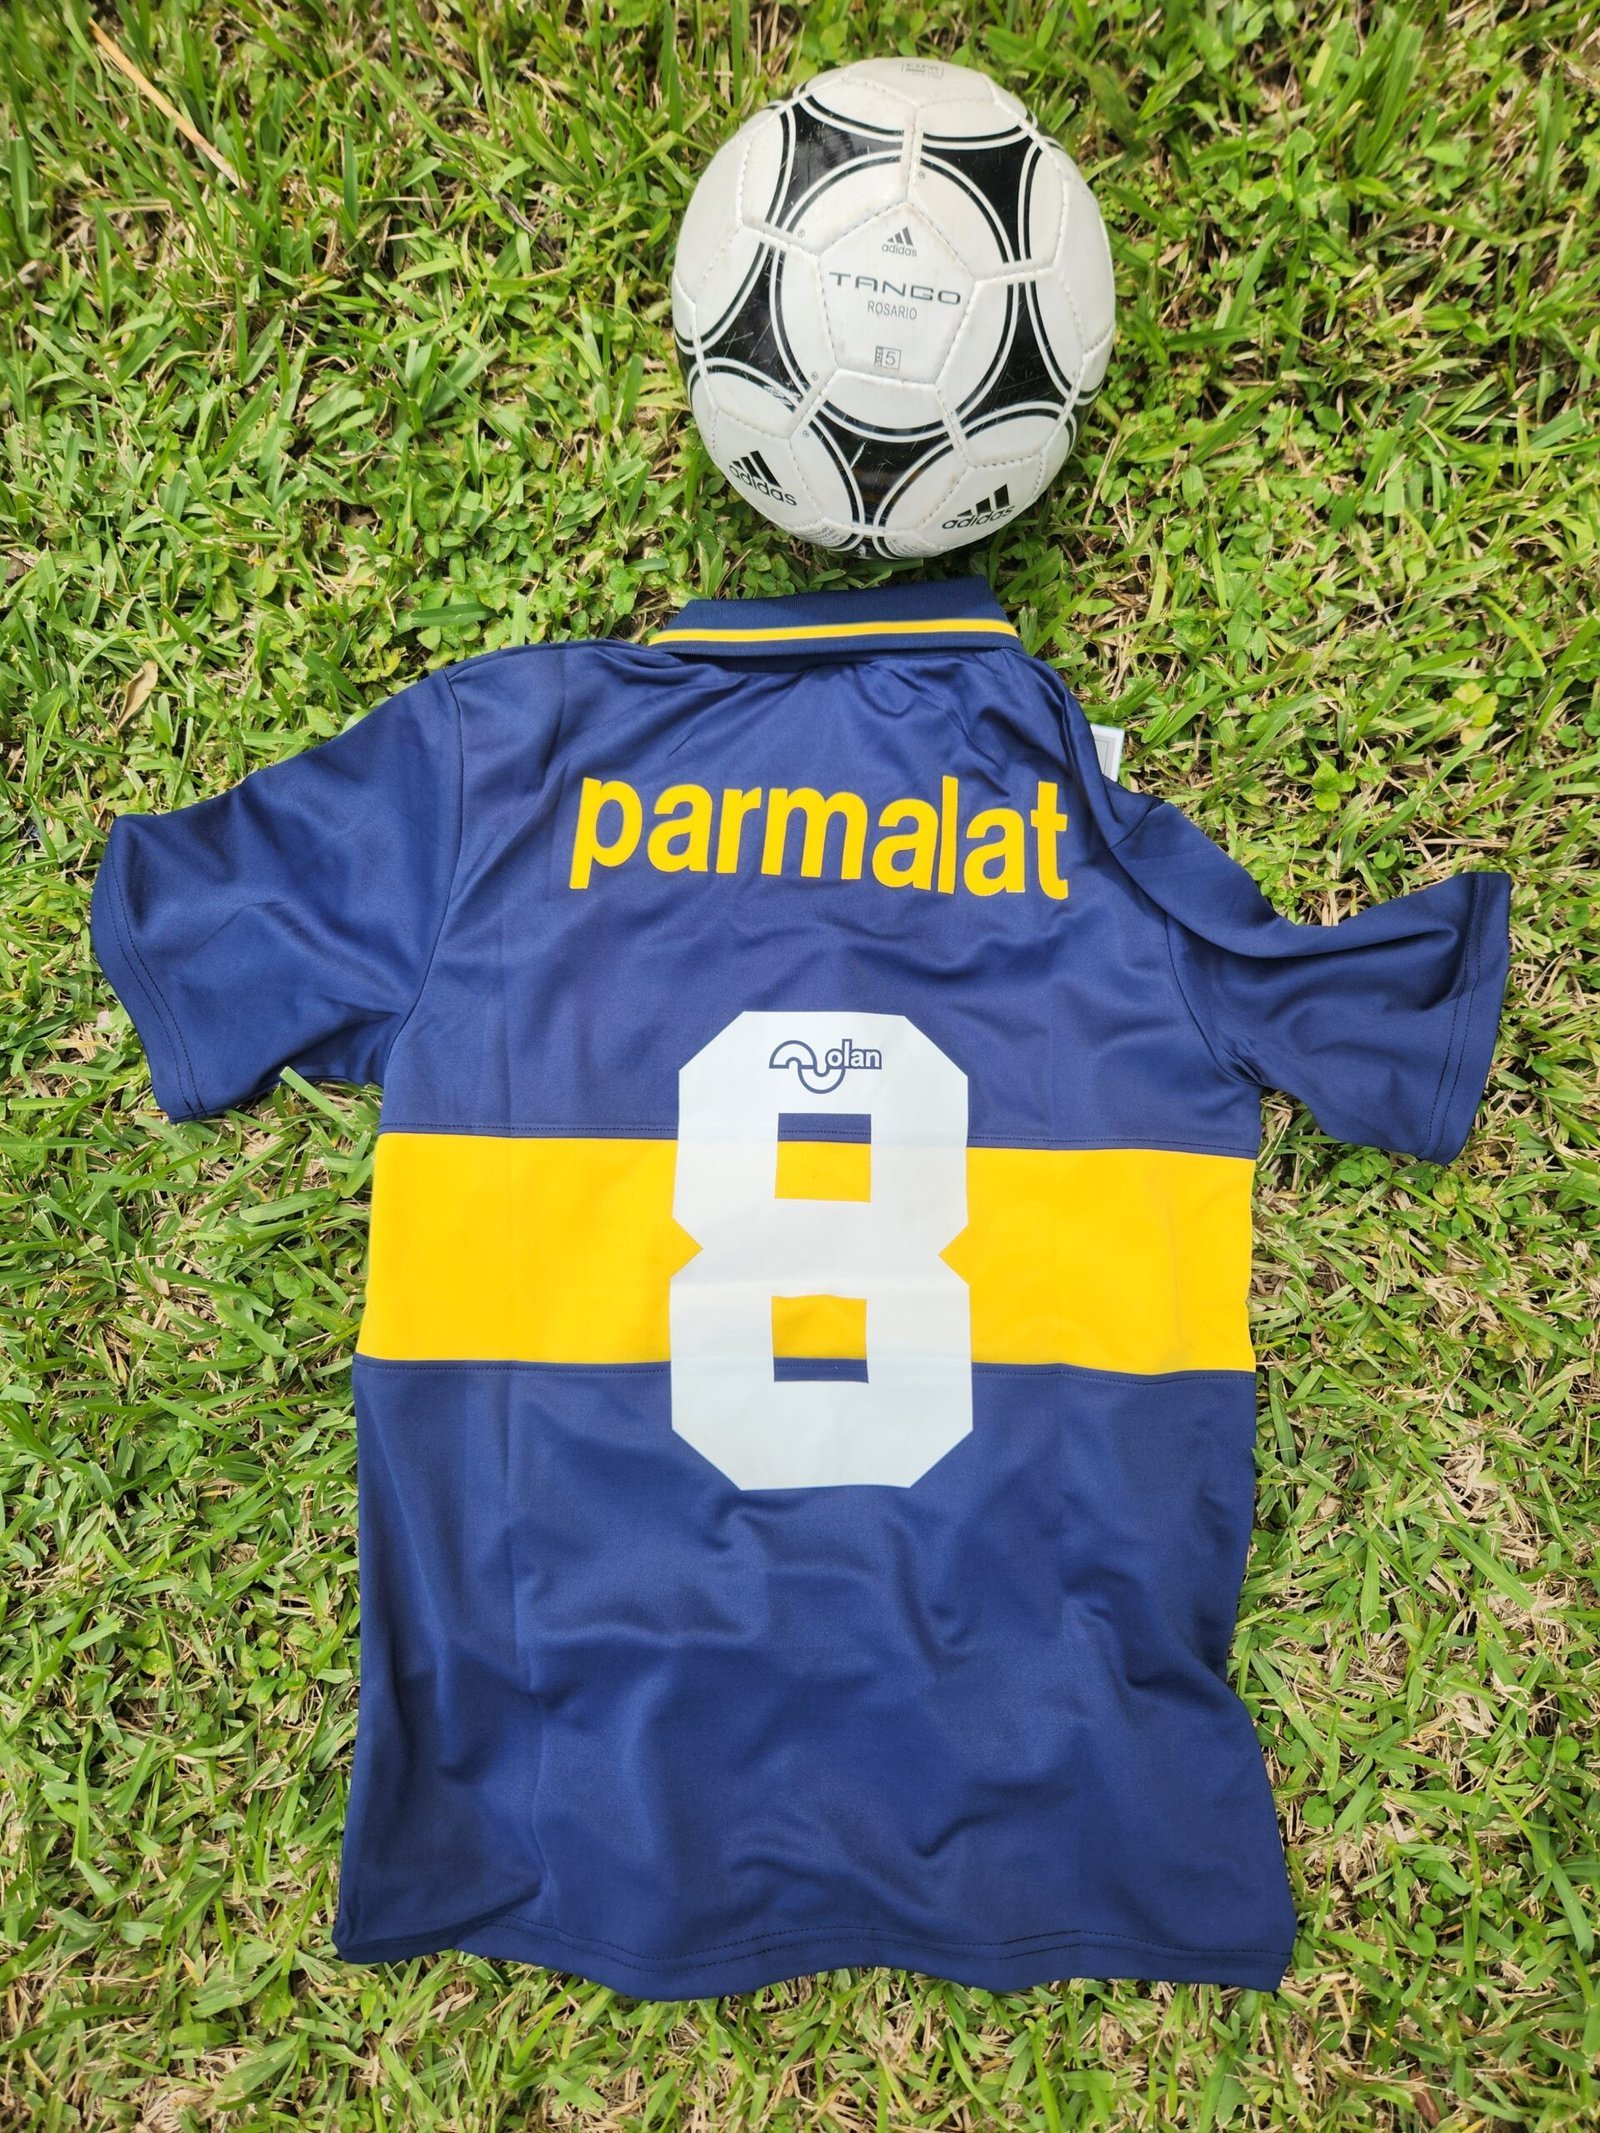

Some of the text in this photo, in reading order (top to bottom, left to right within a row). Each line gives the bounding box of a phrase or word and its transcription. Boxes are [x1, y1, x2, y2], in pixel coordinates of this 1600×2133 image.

[881, 243, 918, 258] adidas
[828, 271, 962, 306] TANGO
[867, 300, 918, 321] ROSARIO
[884, 350, 896, 366] 5
[728, 464, 798, 507] adidas
[941, 504, 1016, 530] adidas
[569, 775, 1069, 900] parmalat
[669, 1010, 974, 1491] 8
